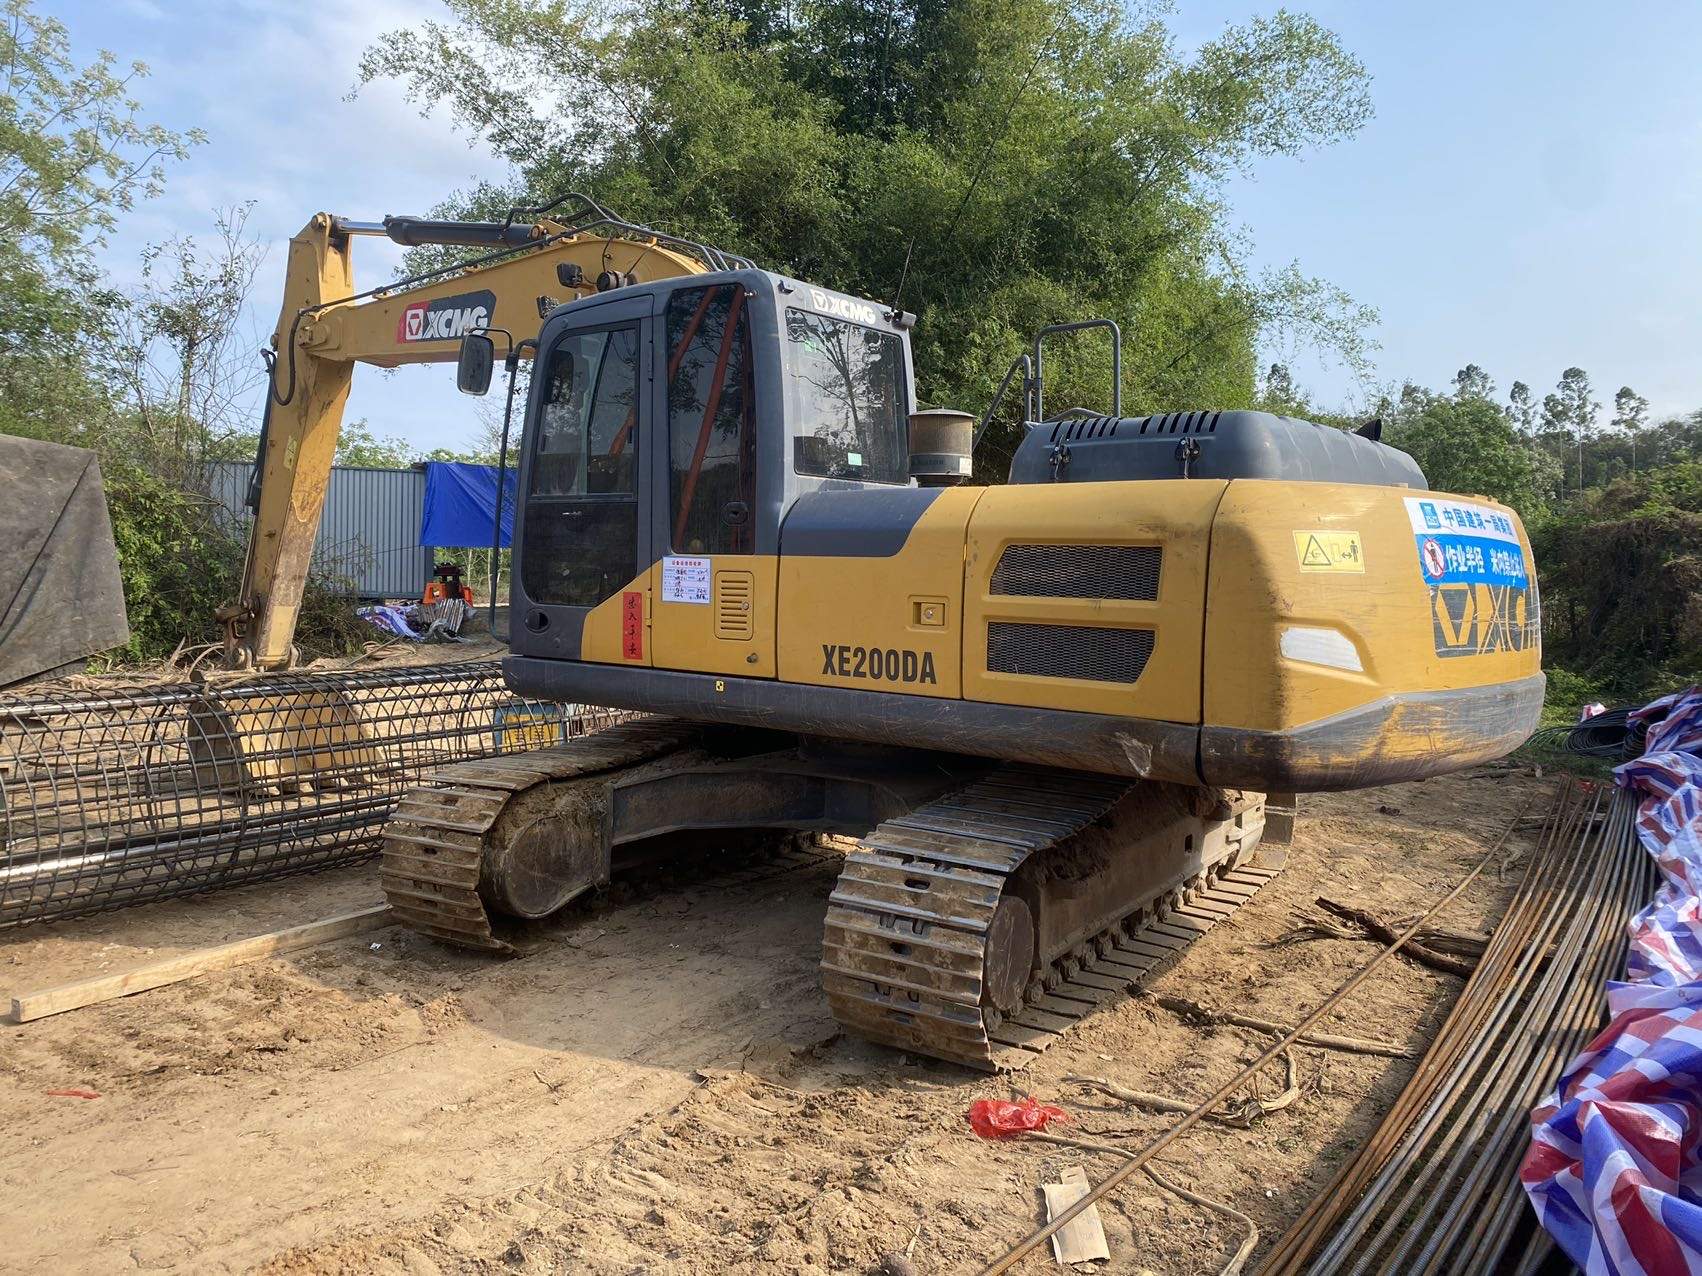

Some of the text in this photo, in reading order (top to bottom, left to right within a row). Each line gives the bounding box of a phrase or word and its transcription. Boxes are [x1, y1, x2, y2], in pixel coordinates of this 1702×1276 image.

[423, 306, 488, 339] XCMG
[827, 296, 875, 325] XCMG
[1445, 544, 1485, 574] 作业半径
[822, 645, 937, 684] XE200DA
